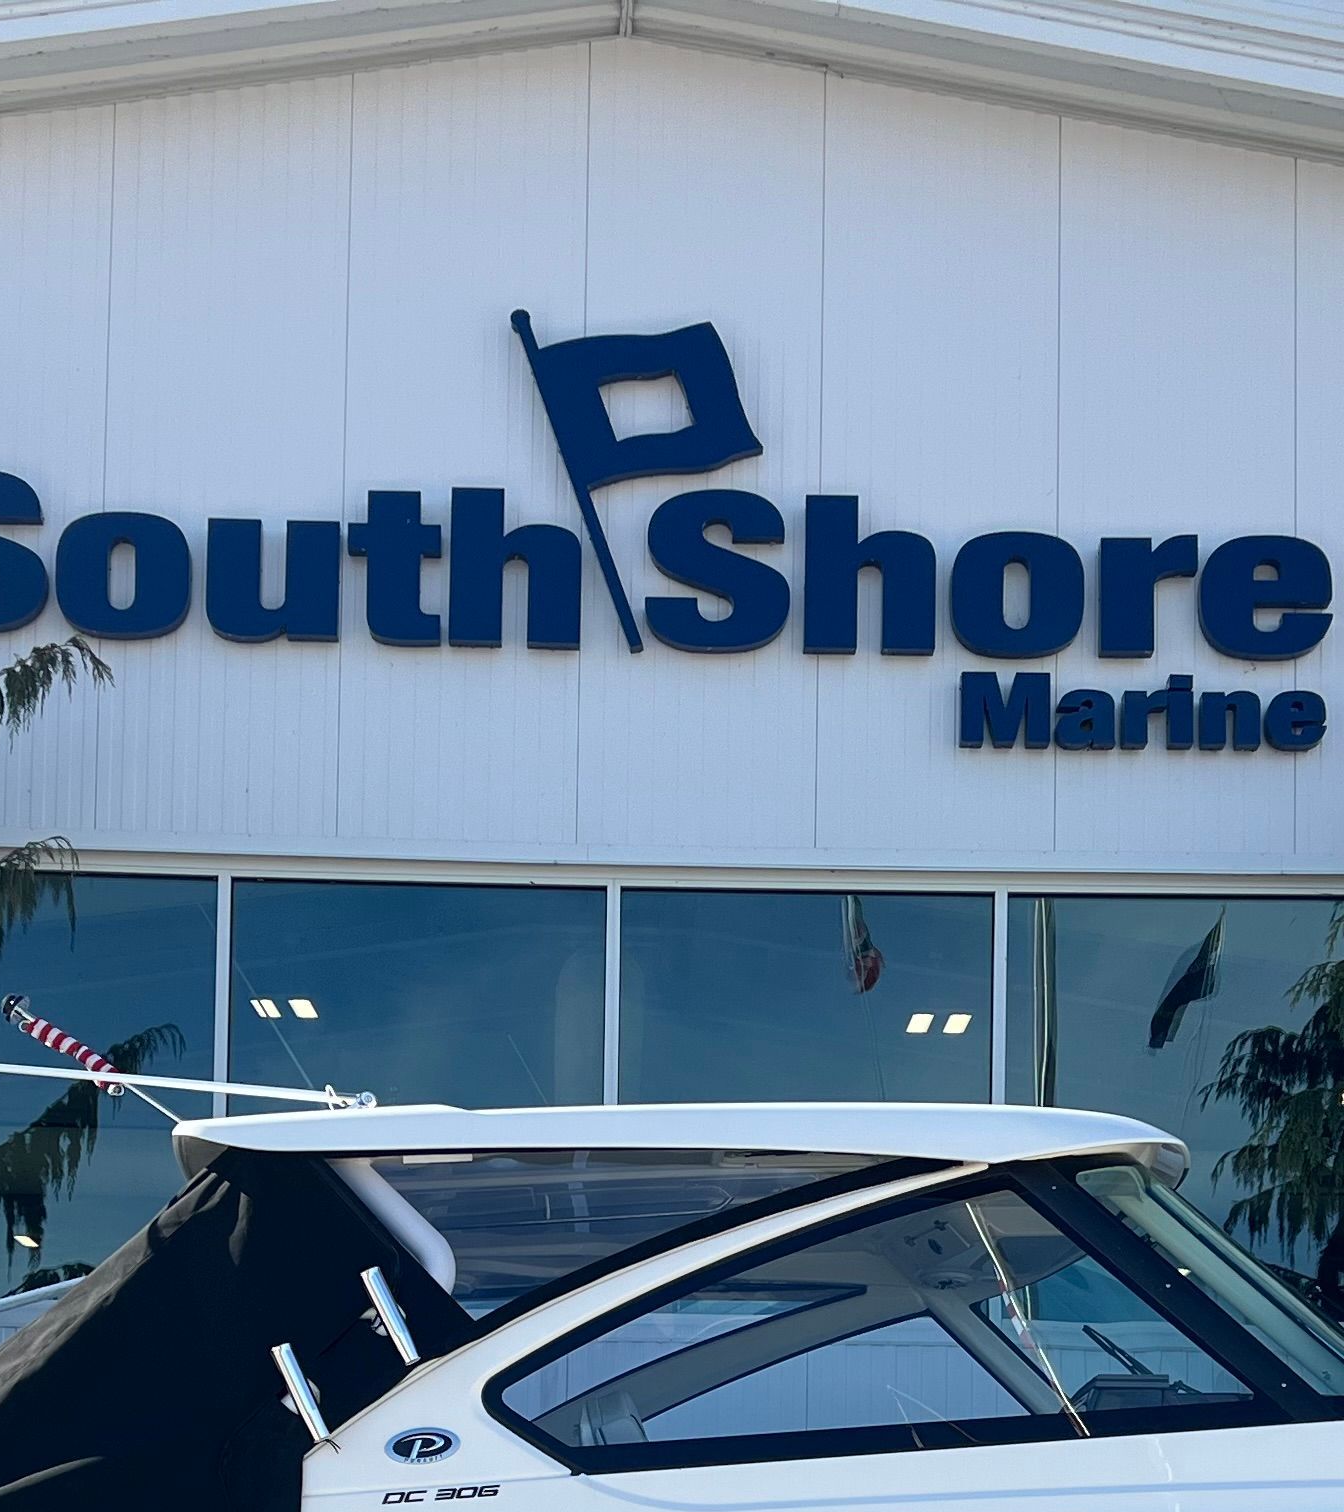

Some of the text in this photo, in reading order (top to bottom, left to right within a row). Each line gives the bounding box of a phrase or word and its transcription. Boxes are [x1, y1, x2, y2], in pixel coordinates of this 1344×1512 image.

[644, 488, 1335, 666] Shore
[958, 671, 1328, 757] Marine
[381, 1484, 501, 1505] DC 306
